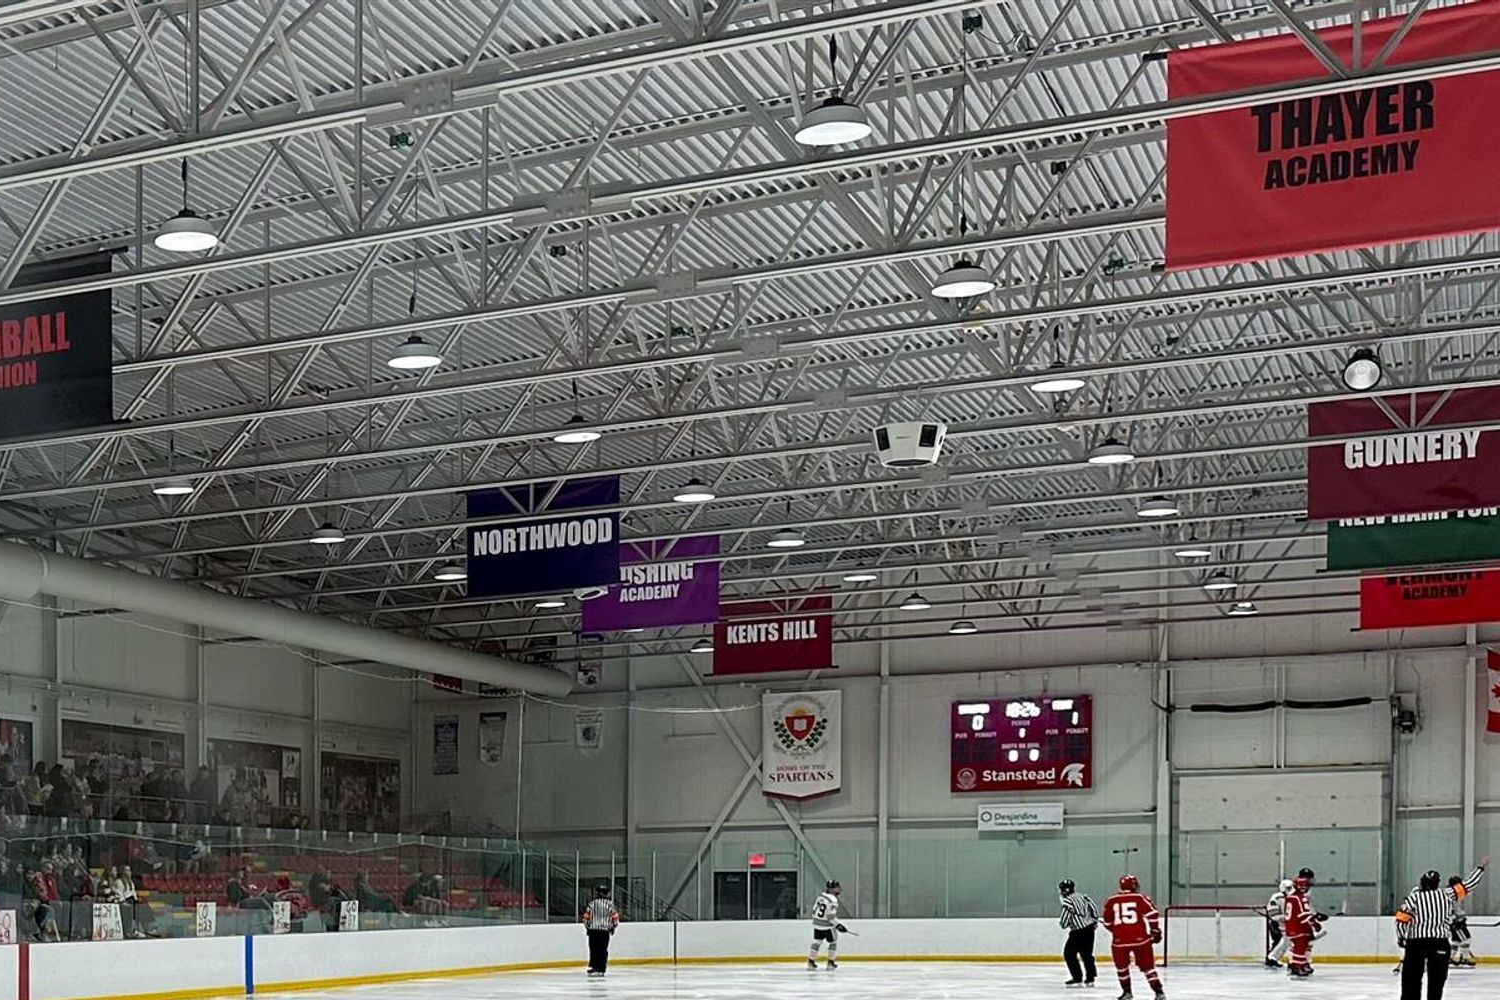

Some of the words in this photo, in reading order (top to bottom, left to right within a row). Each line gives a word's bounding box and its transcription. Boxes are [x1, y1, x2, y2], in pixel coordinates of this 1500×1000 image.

[1251, 79, 1435, 153] THAYER
[1264, 140, 1421, 190] ACADEMY
[1344, 430, 1481, 470] GUNNERY
[473, 517, 613, 557] NORTHWOOD
[620, 562, 694, 585] USHING
[620, 584, 680, 602] ACADEMY
[1402, 585, 1467, 601] ACADEMY
[727, 622, 780, 644] KENTS
[782, 619, 818, 641] HILL
[768, 770, 835, 783] SPARTANS
[982, 767, 1056, 782] Stanstead
[1112, 902, 1138, 925] 15
